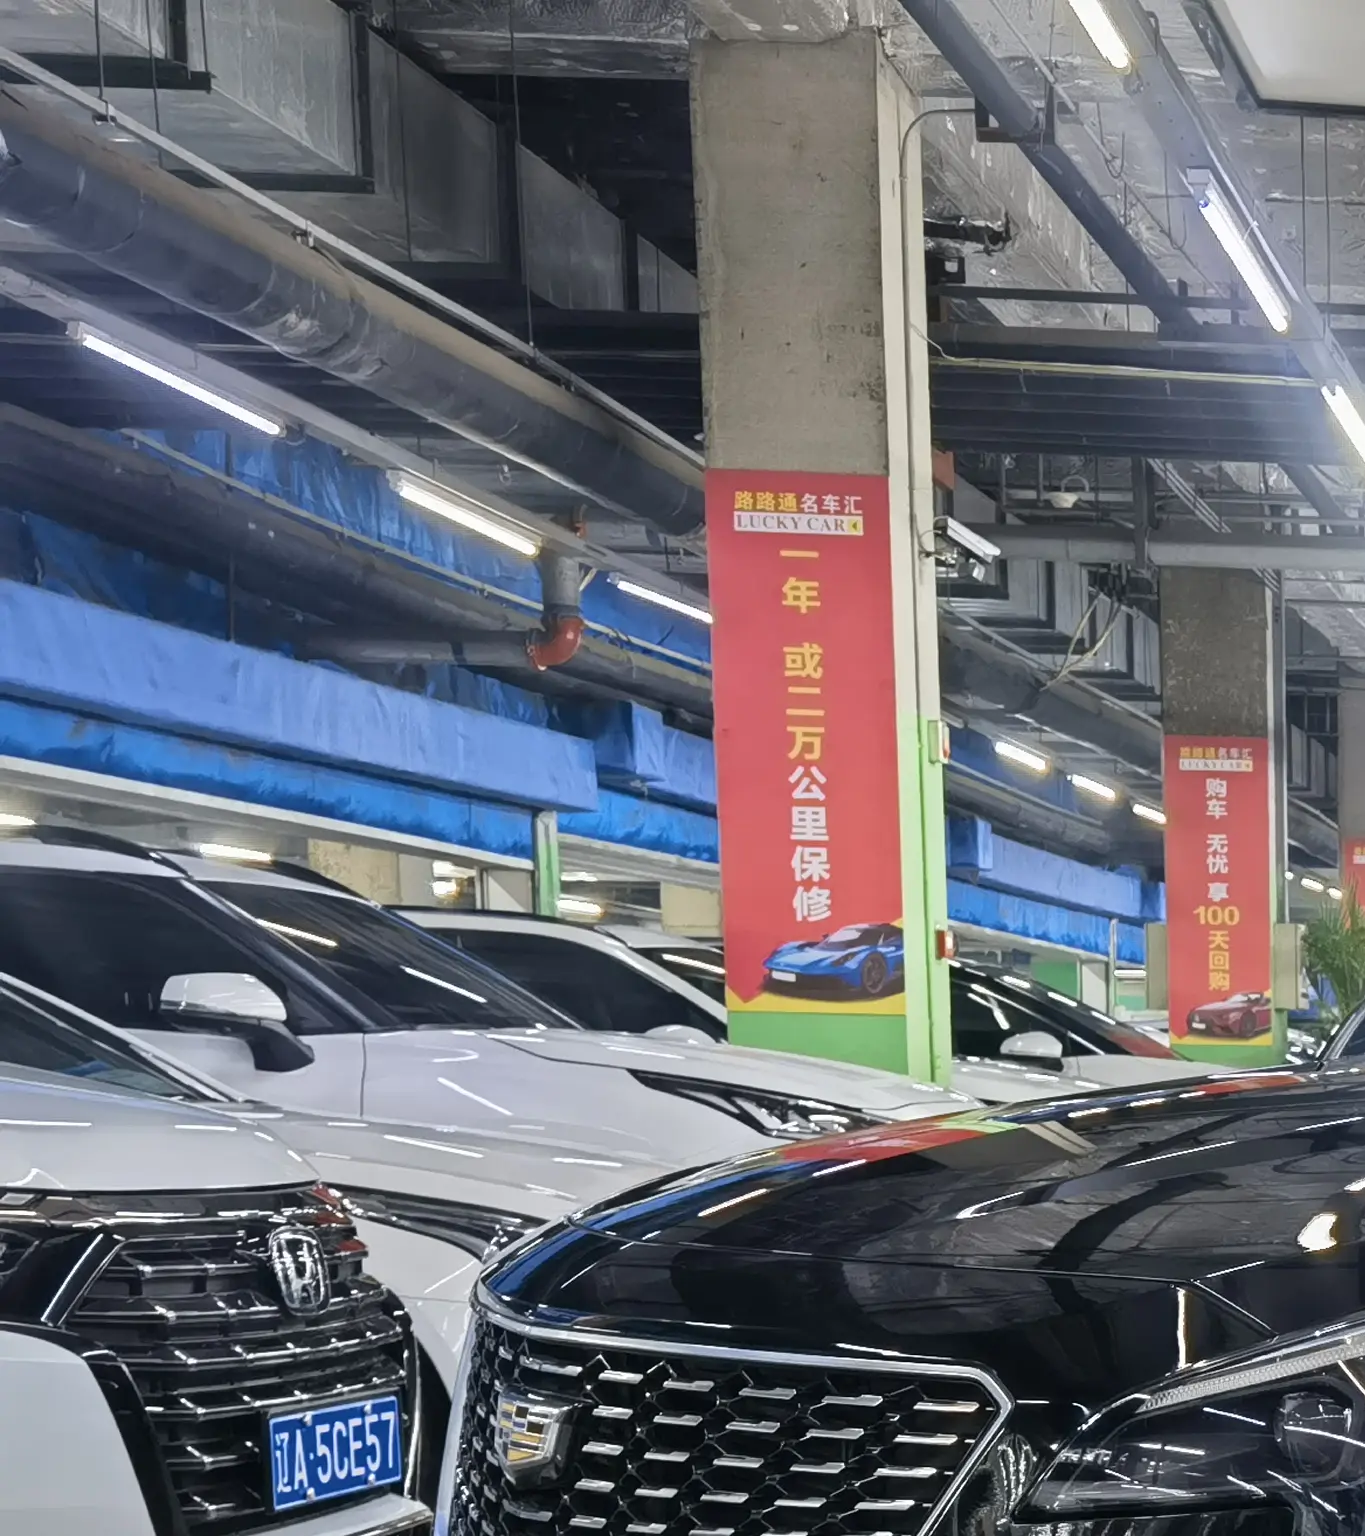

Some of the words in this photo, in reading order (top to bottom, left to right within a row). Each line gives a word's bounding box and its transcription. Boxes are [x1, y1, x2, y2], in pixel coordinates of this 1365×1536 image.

[733, 490, 863, 515] 路路通名车汇
[735, 514, 801, 530] LUCKY
[806, 517, 846, 533] CAR
